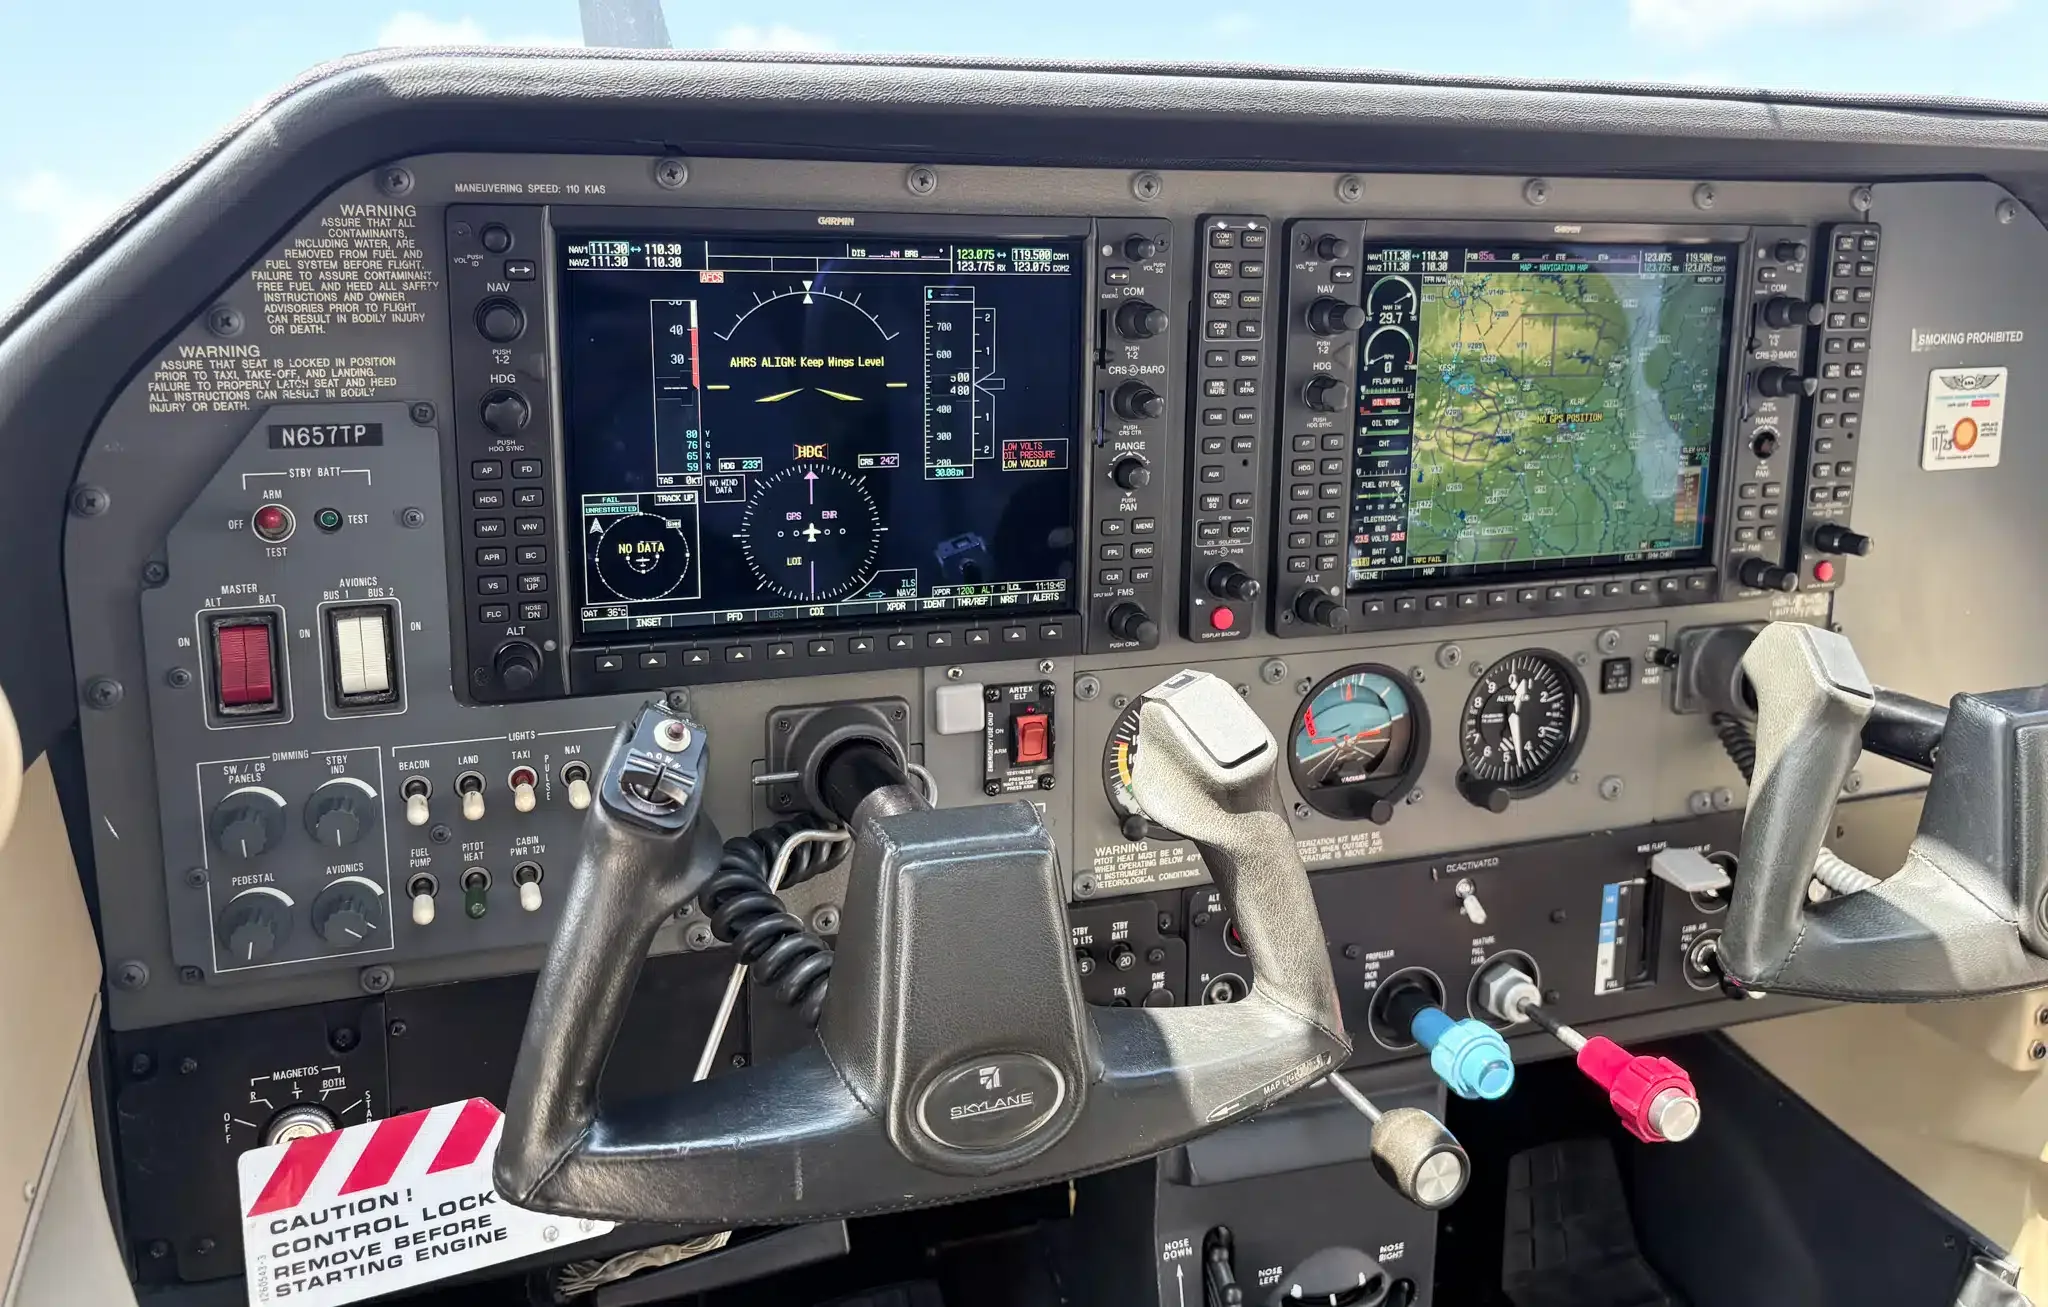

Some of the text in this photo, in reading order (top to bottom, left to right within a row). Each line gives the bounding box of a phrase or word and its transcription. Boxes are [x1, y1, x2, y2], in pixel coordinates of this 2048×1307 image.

[455, 184, 605, 194] MANEUVERING SPEED: 110 KIAS
[340, 204, 416, 217] WARNING
[321, 218, 415, 227] ASSURE THAT ALL
[818, 217, 854, 226] GARMIN
[329, 229, 407, 239] CONTAMINANTS,
[295, 239, 415, 250] INCLUDING WATER, ARE
[568, 244, 681, 254] NAV1 111.30 110.30
[285, 249, 423, 259] REMOVED FROM FUEL AND
[957, 249, 994, 260] 123.075
[1013, 250, 1050, 260] 119.500
[1422, 252, 1448, 260] 110.30
[569, 256, 681, 267] NAV2 111.30 110.30
[957, 262, 994, 272] 123.775
[1014, 262, 1050, 272] 123.075
[701, 273, 723, 282] AFCS
[487, 283, 510, 292] NAV
[1317, 285, 1334, 293] NAV
[1771, 284, 1786, 292] COM
[1380, 313, 1402, 324] 29.7
[1919, 331, 2023, 345] SMOKING PROHIBITED
[179, 345, 260, 358] WARNING
[730, 357, 884, 368] AHRS ALIGN: Keep Wings Level
[1109, 366, 1165, 374] CRS BARO
[490, 374, 515, 383] HDG
[1537, 413, 1602, 423] NO GPS POSITION
[282, 425, 366, 447] N657TP
[1021, 442, 1042, 450] VOLTS
[1115, 442, 1145, 450] RANGE
[1004, 451, 1017, 459] OIL
[1004, 459, 1047, 468] LOW VACUUM
[289, 467, 340, 478] STBY BATT
[263, 490, 282, 500] ARM
[1120, 503, 1137, 511] PAN
[348, 514, 368, 524] TEST
[228, 520, 244, 529] OFF
[266, 548, 287, 558] TEST
[619, 543, 664, 554] NO DATA
[340, 577, 378, 587] AVIONICS
[221, 584, 258, 594] MASTER
[368, 588, 394, 598] BUS 2
[1117, 588, 1134, 596] FMS
[259, 594, 276, 604] BAT
[324, 590, 349, 600] BUS 1
[1033, 593, 1059, 601] ALERTS
[205, 598, 222, 607] ALT
[887, 602, 906, 611] XPDR
[923, 599, 945, 608] IDENT
[809, 607, 824, 616] CDI
[636, 618, 662, 627] INSET
[727, 613, 743, 622] PFD
[411, 622, 421, 630] ON
[506, 627, 525, 635] ALT
[300, 629, 310, 638] ON
[178, 638, 190, 647] ON
[509, 731, 535, 741] LIGHTS
[512, 751, 530, 759] TAXI
[565, 746, 581, 754] NAV
[272, 750, 309, 761] DIMMING
[326, 755, 347, 765] STBY
[458, 755, 478, 765] LAND
[224, 763, 265, 775] SW CB
[331, 765, 344, 774] IND
[399, 760, 430, 770] BEACON
[229, 773, 261, 784] PANELS
[516, 836, 539, 846] CABIN
[463, 842, 484, 851] PITOT
[510, 845, 545, 856] PWR 12V
[1096, 842, 1148, 857] WARNING
[411, 848, 429, 857] FUEL
[464, 852, 484, 861] HEAT
[1094, 848, 1183, 866] PITOT HEAT MUST BE ON
[410, 858, 431, 867] PUMP
[1446, 858, 1498, 873] DEACTIVATED
[326, 863, 363, 874] AVIONICS
[232, 873, 274, 886] PEDESTAL
[1113, 921, 1128, 931] STBY
[1112, 931, 1128, 940] BATT
[1120, 956, 1131, 966] 20
[273, 1066, 319, 1082] MAGNETOS
[323, 1078, 345, 1089] BOTH
[950, 1093, 1032, 1117] SKYLANE
[272, 1190, 496, 1258] CONTROL LOCK
[274, 1214, 492, 1280] REMOVE BEFORE
[1165, 1238, 1189, 1250] NOSE
[1163, 1247, 1192, 1260] DOWN
[276, 1227, 508, 1298] STARTING ENGINE
[1258, 1267, 1282, 1277] NOSE
[1259, 1275, 1279, 1285] LEFT
